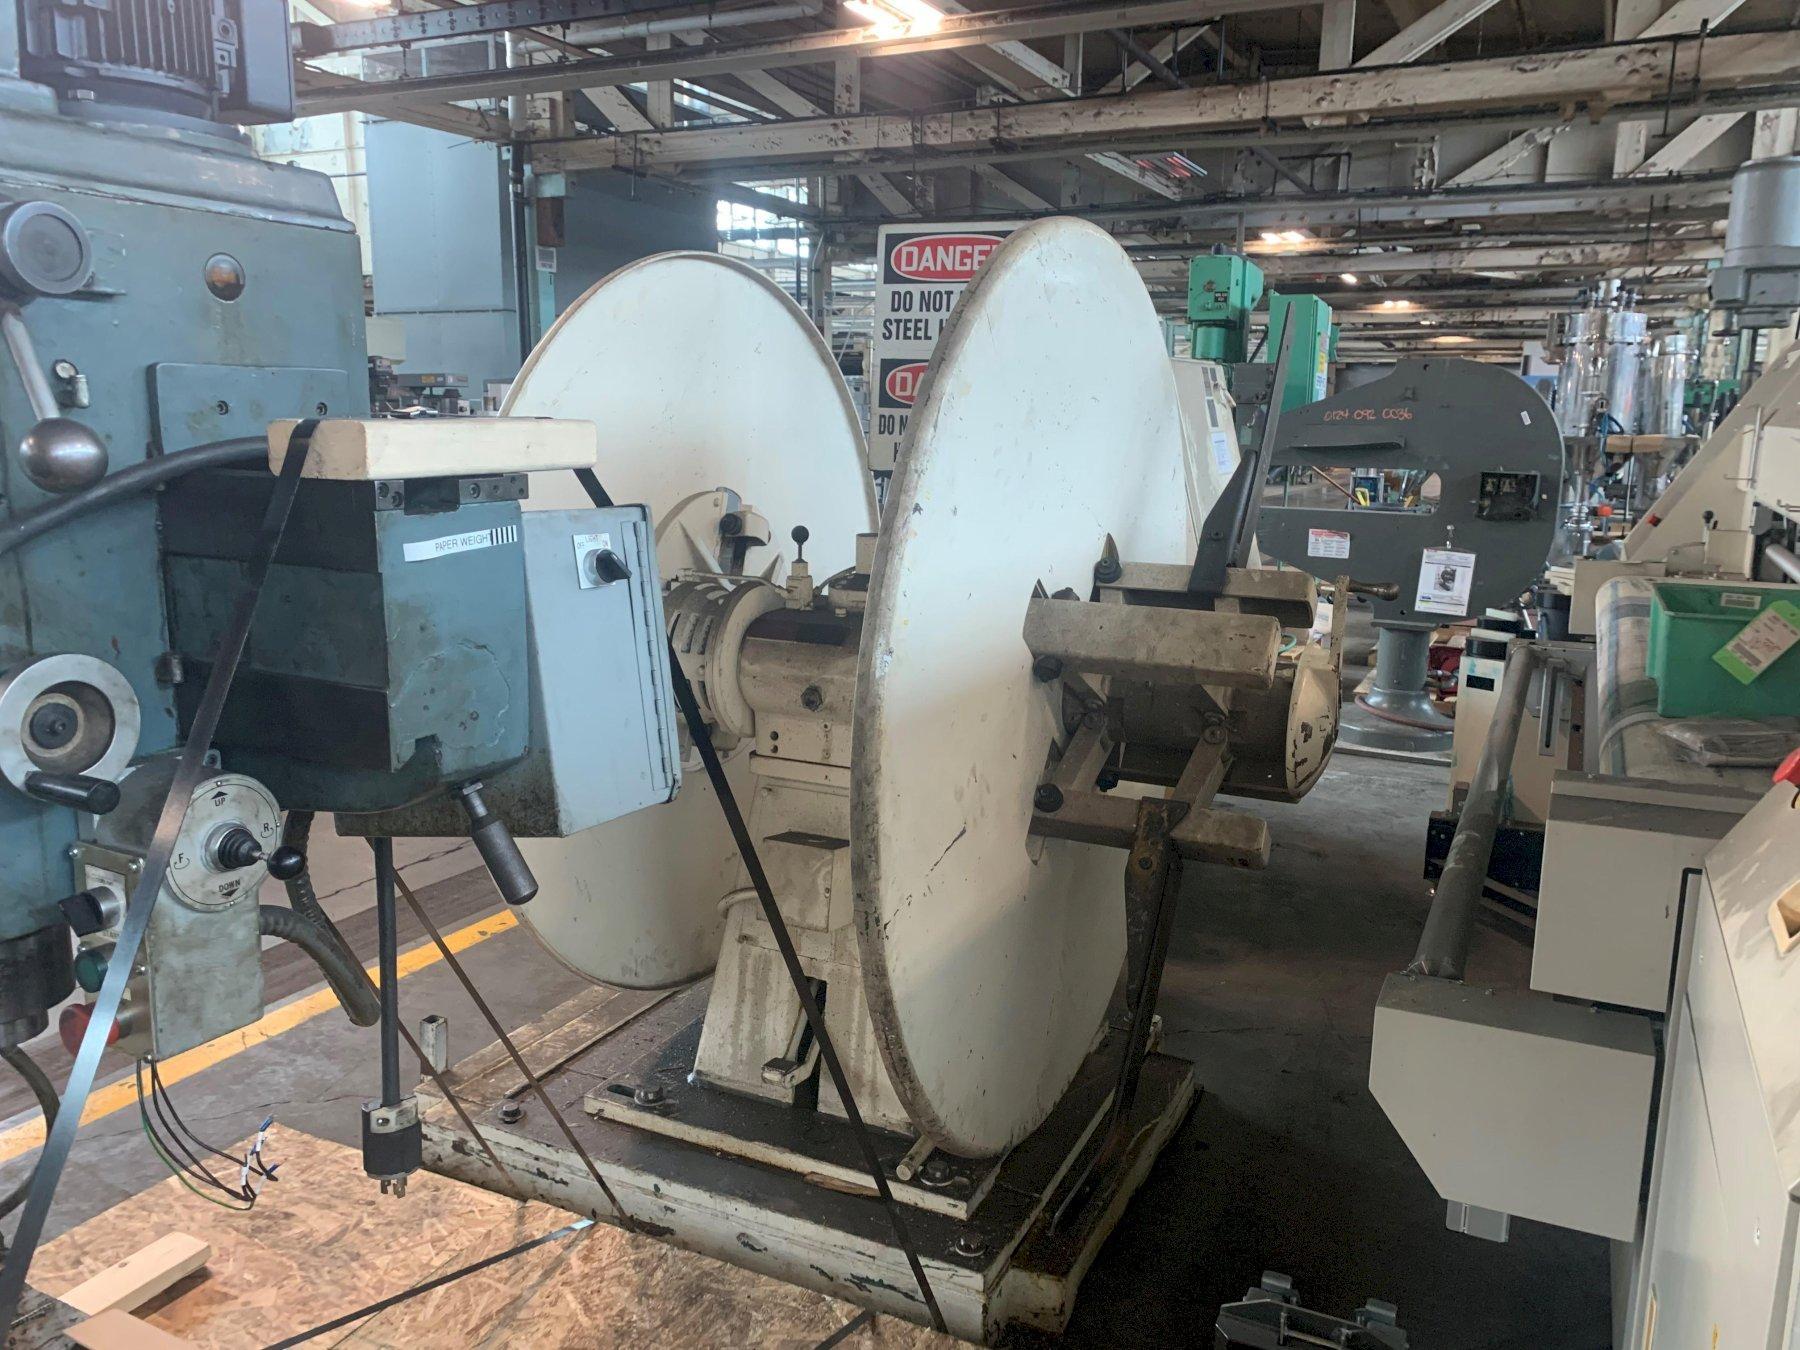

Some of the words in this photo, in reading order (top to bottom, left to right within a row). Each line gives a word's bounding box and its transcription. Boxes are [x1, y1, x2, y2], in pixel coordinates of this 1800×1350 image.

[900, 245, 1000, 271] DANGE
[891, 290, 913, 312] DO
[919, 290, 953, 312] NOT
[882, 318, 932, 340] STEEL
[878, 414, 895, 435] DO
[435, 538, 458, 552] PAPER
[214, 797, 226, 807] UP
[263, 823, 270, 832] R
[178, 853, 184, 864] F
[218, 879, 241, 893] DOWN
